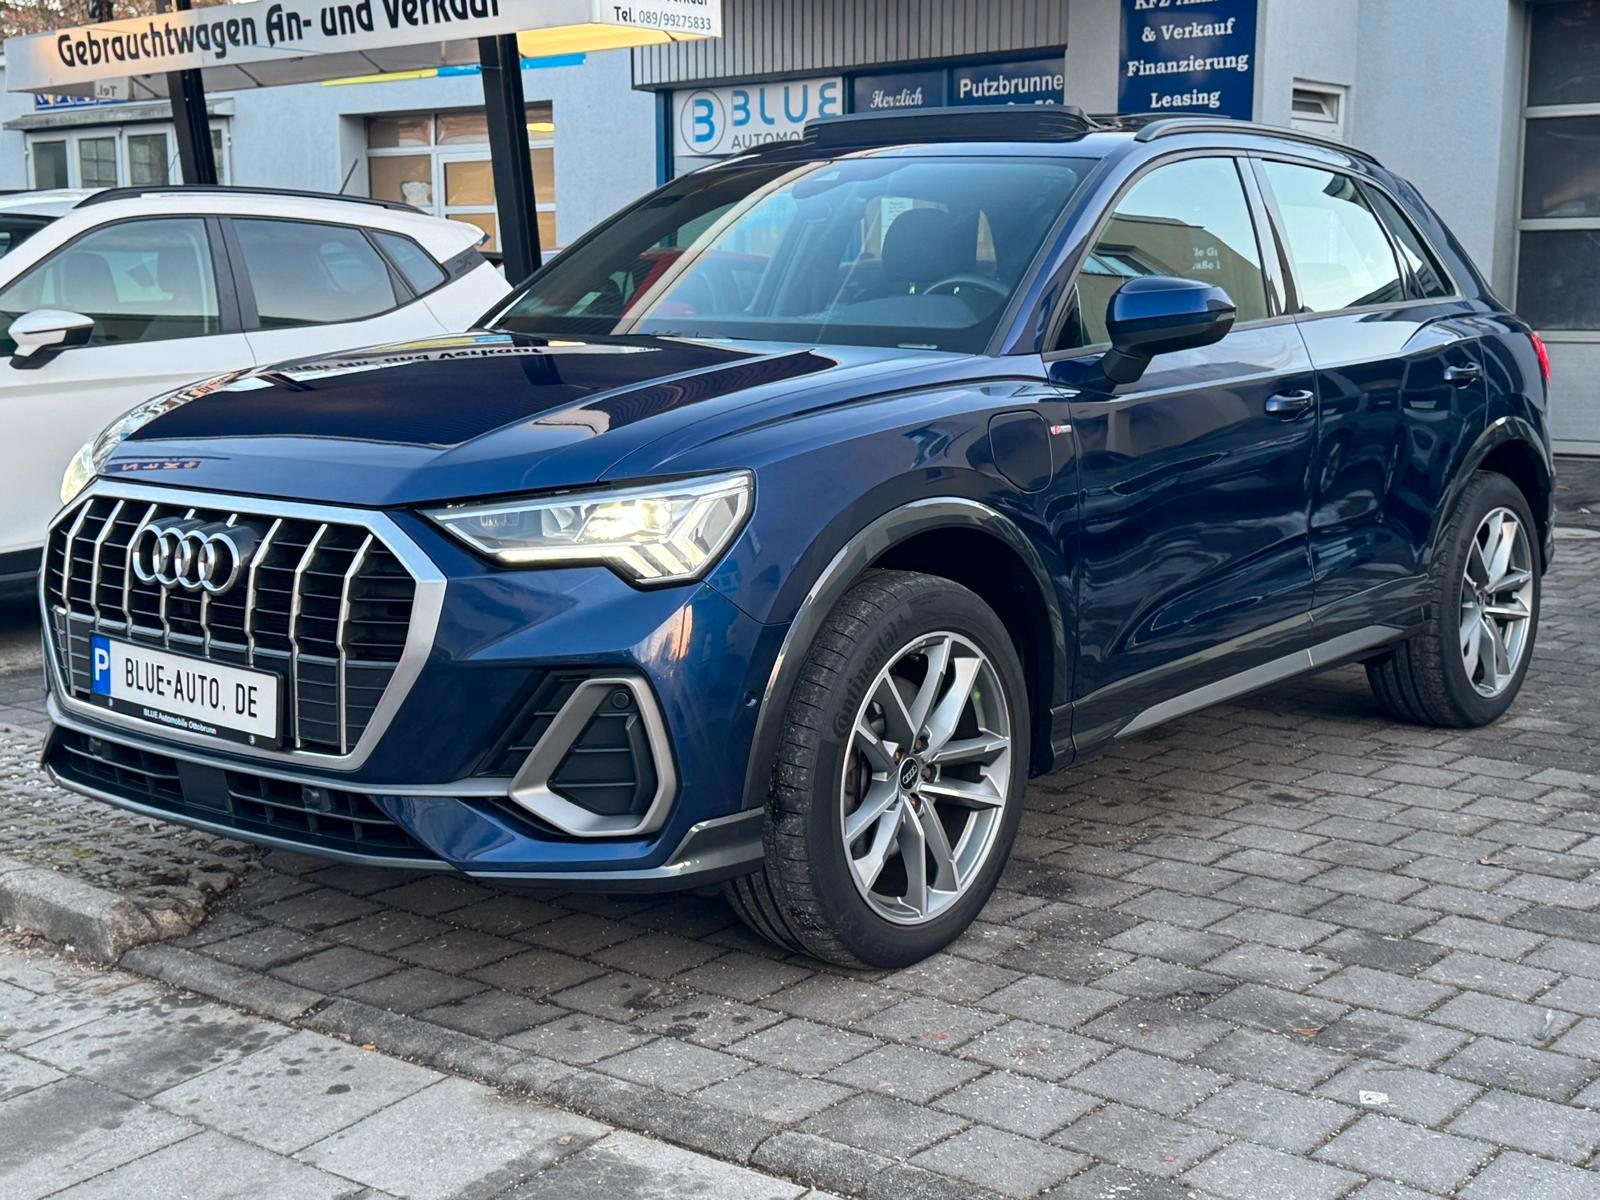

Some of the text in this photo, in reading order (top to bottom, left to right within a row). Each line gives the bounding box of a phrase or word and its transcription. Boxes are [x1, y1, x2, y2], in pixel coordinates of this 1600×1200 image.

[613, 6, 712, 30] Tel. 089/99275833
[1141, 18, 1236, 42] & Verkauf
[57, 16, 257, 67] Gebrauchtwagen
[266, 4, 312, 48] An-
[321, 0, 374, 37] und
[1127, 54, 1249, 77] Finanzierung
[870, 88, 923, 108] Herzlich
[959, 74, 1064, 98] Putzbrunne
[732, 81, 837, 127] BLUE
[1150, 89, 1221, 108] Leasing
[731, 131, 801, 150] AUTOMO
[94, 647, 110, 681] P
[236, 683, 258, 718] DE
[143, 707, 158, 719] BLUE
